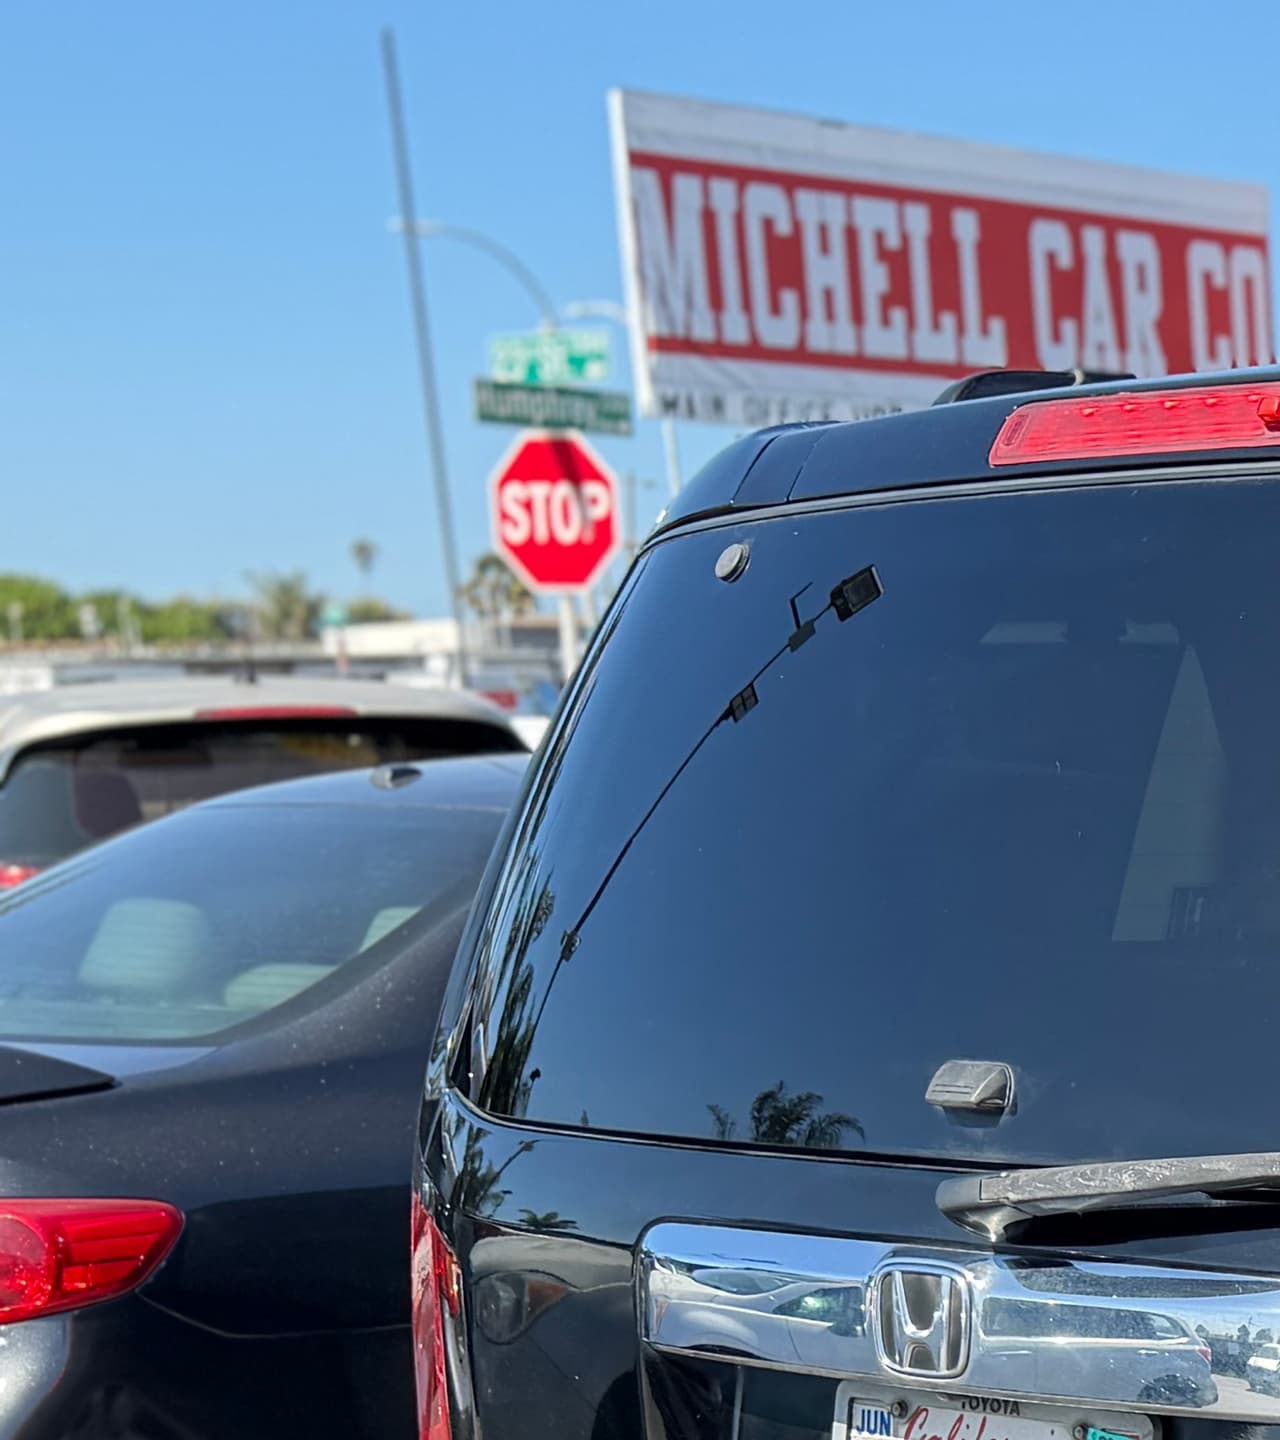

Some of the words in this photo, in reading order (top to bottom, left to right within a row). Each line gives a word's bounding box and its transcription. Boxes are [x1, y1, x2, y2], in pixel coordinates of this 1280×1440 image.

[631, 166, 1008, 368] MICHELL
[1029, 216, 1168, 378] CAR
[500, 479, 610, 546] STOP
[856, 1408, 892, 1437] JUN
[961, 1396, 1021, 1416] TOYOTA
